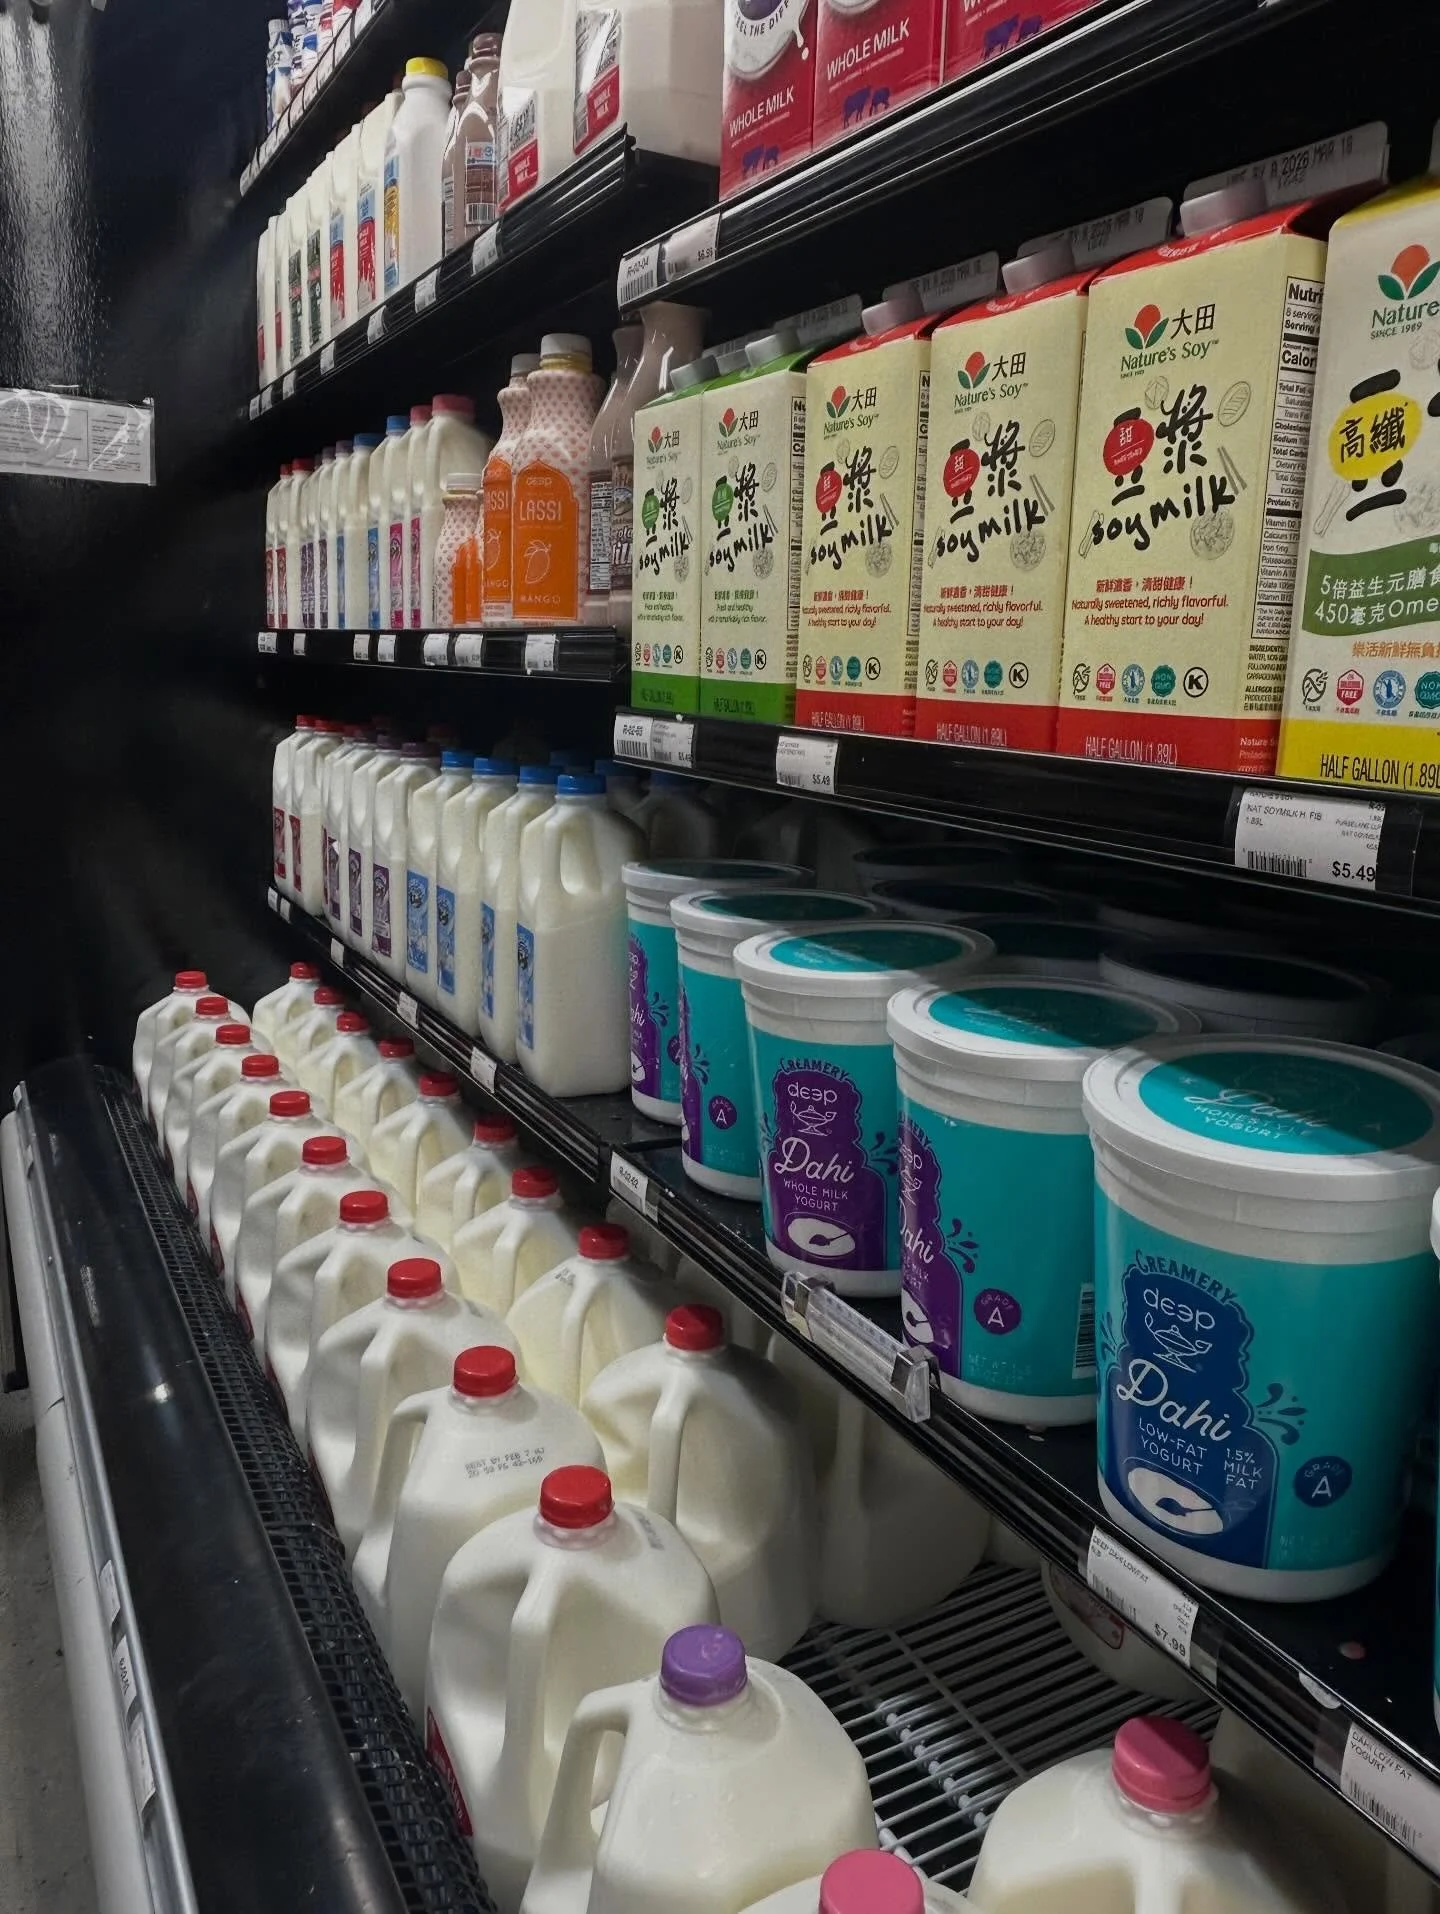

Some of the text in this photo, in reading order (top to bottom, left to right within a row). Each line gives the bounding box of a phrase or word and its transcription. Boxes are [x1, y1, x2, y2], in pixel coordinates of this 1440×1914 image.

[826, 18, 910, 81] WHOLE MILK
[729, 85, 795, 138] WHOLE MILK
[1170, 303, 1216, 340] 大田
[1370, 320, 1423, 340] SINCE 1989
[992, 352, 1026, 381] 大田
[1120, 346, 1177, 372] Nature's
[851, 386, 877, 412] 大田
[954, 387, 995, 407] Nature's
[739, 410, 759, 432] 大田
[824, 417, 854, 435] Nature's
[520, 500, 562, 521] LASSI
[1267, 497, 1291, 508] Protein
[1265, 518, 1287, 529] Vitamin
[1072, 594, 1229, 611] Naturally sweetened, richly flavorful.
[1090, 613, 1119, 627] healthy
[1121, 614, 1143, 627] start
[1145, 614, 1155, 625] to
[1157, 615, 1180, 627] your
[1181, 612, 1204, 627] day!
[1085, 737, 1106, 757] HALF
[1108, 738, 1143, 763] GALLON
[1320, 754, 1349, 779] HALF
[1352, 755, 1399, 786] GALLON
[1331, 860, 1377, 882] $5.49
[780, 1058, 851, 1081] CREAMERY
[716, 1109, 728, 1125] A
[1204, 1116, 1288, 1139] YOGURT
[774, 1137, 855, 1183] Dahi
[784, 1178, 849, 1200] WHOLE MILK
[794, 1196, 839, 1211] YOGURT
[1135, 1249, 1238, 1306] CREAMERY
[987, 1309, 1005, 1328] A
[1116, 1358, 1232, 1441] Dahi
[1139, 1416, 1208, 1460] LOW-FAT
[1141, 1435, 1204, 1476] YOGURT
[1226, 1448, 1256, 1464] 1.5%
[1224, 1462, 1264, 1479] MILK
[1304, 1461, 1346, 1479] GRADE
[1225, 1474, 1259, 1490] FAT
[1312, 1475, 1332, 1498] A
[1154, 1623, 1187, 1657] $7.99
[1350, 1742, 1386, 1773] YOGURT
